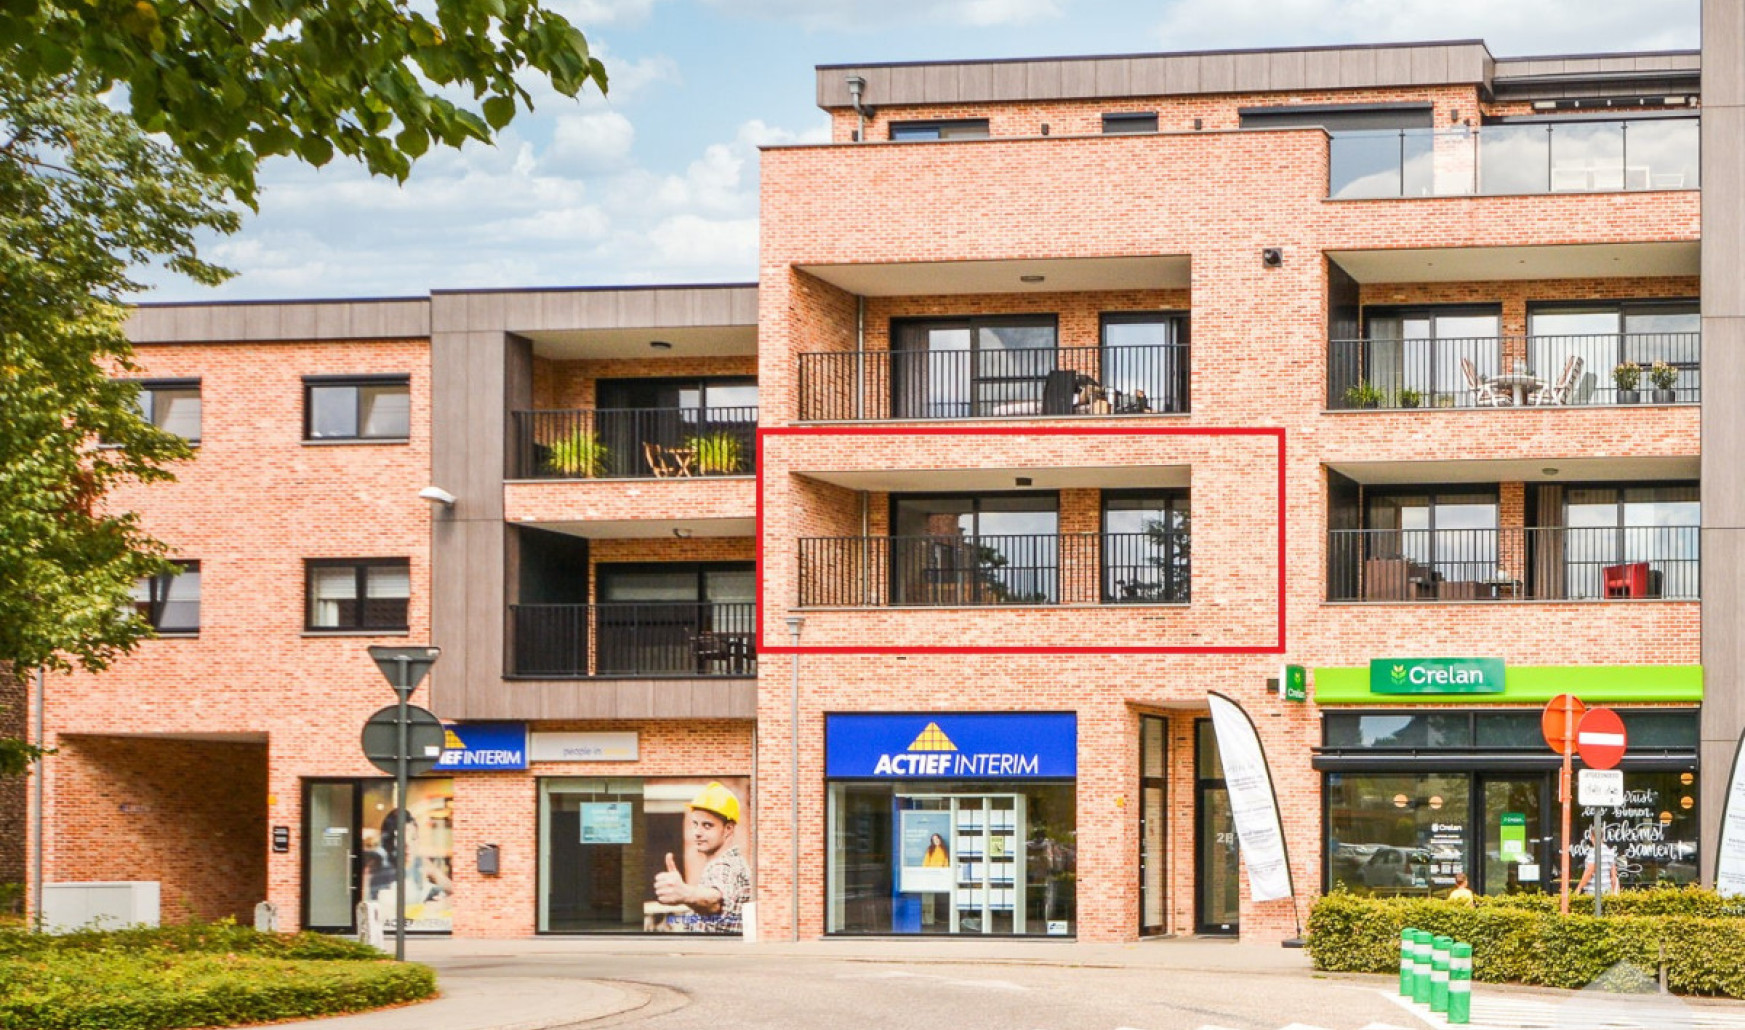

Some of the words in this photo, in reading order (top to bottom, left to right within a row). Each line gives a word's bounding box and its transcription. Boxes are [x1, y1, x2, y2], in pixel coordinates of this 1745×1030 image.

[1408, 665, 1483, 684] Crelan
[438, 750, 463, 765] IEF
[464, 750, 521, 765] INTERIM
[873, 753, 952, 775] ACTIEF
[954, 753, 1039, 775] INTERIM
